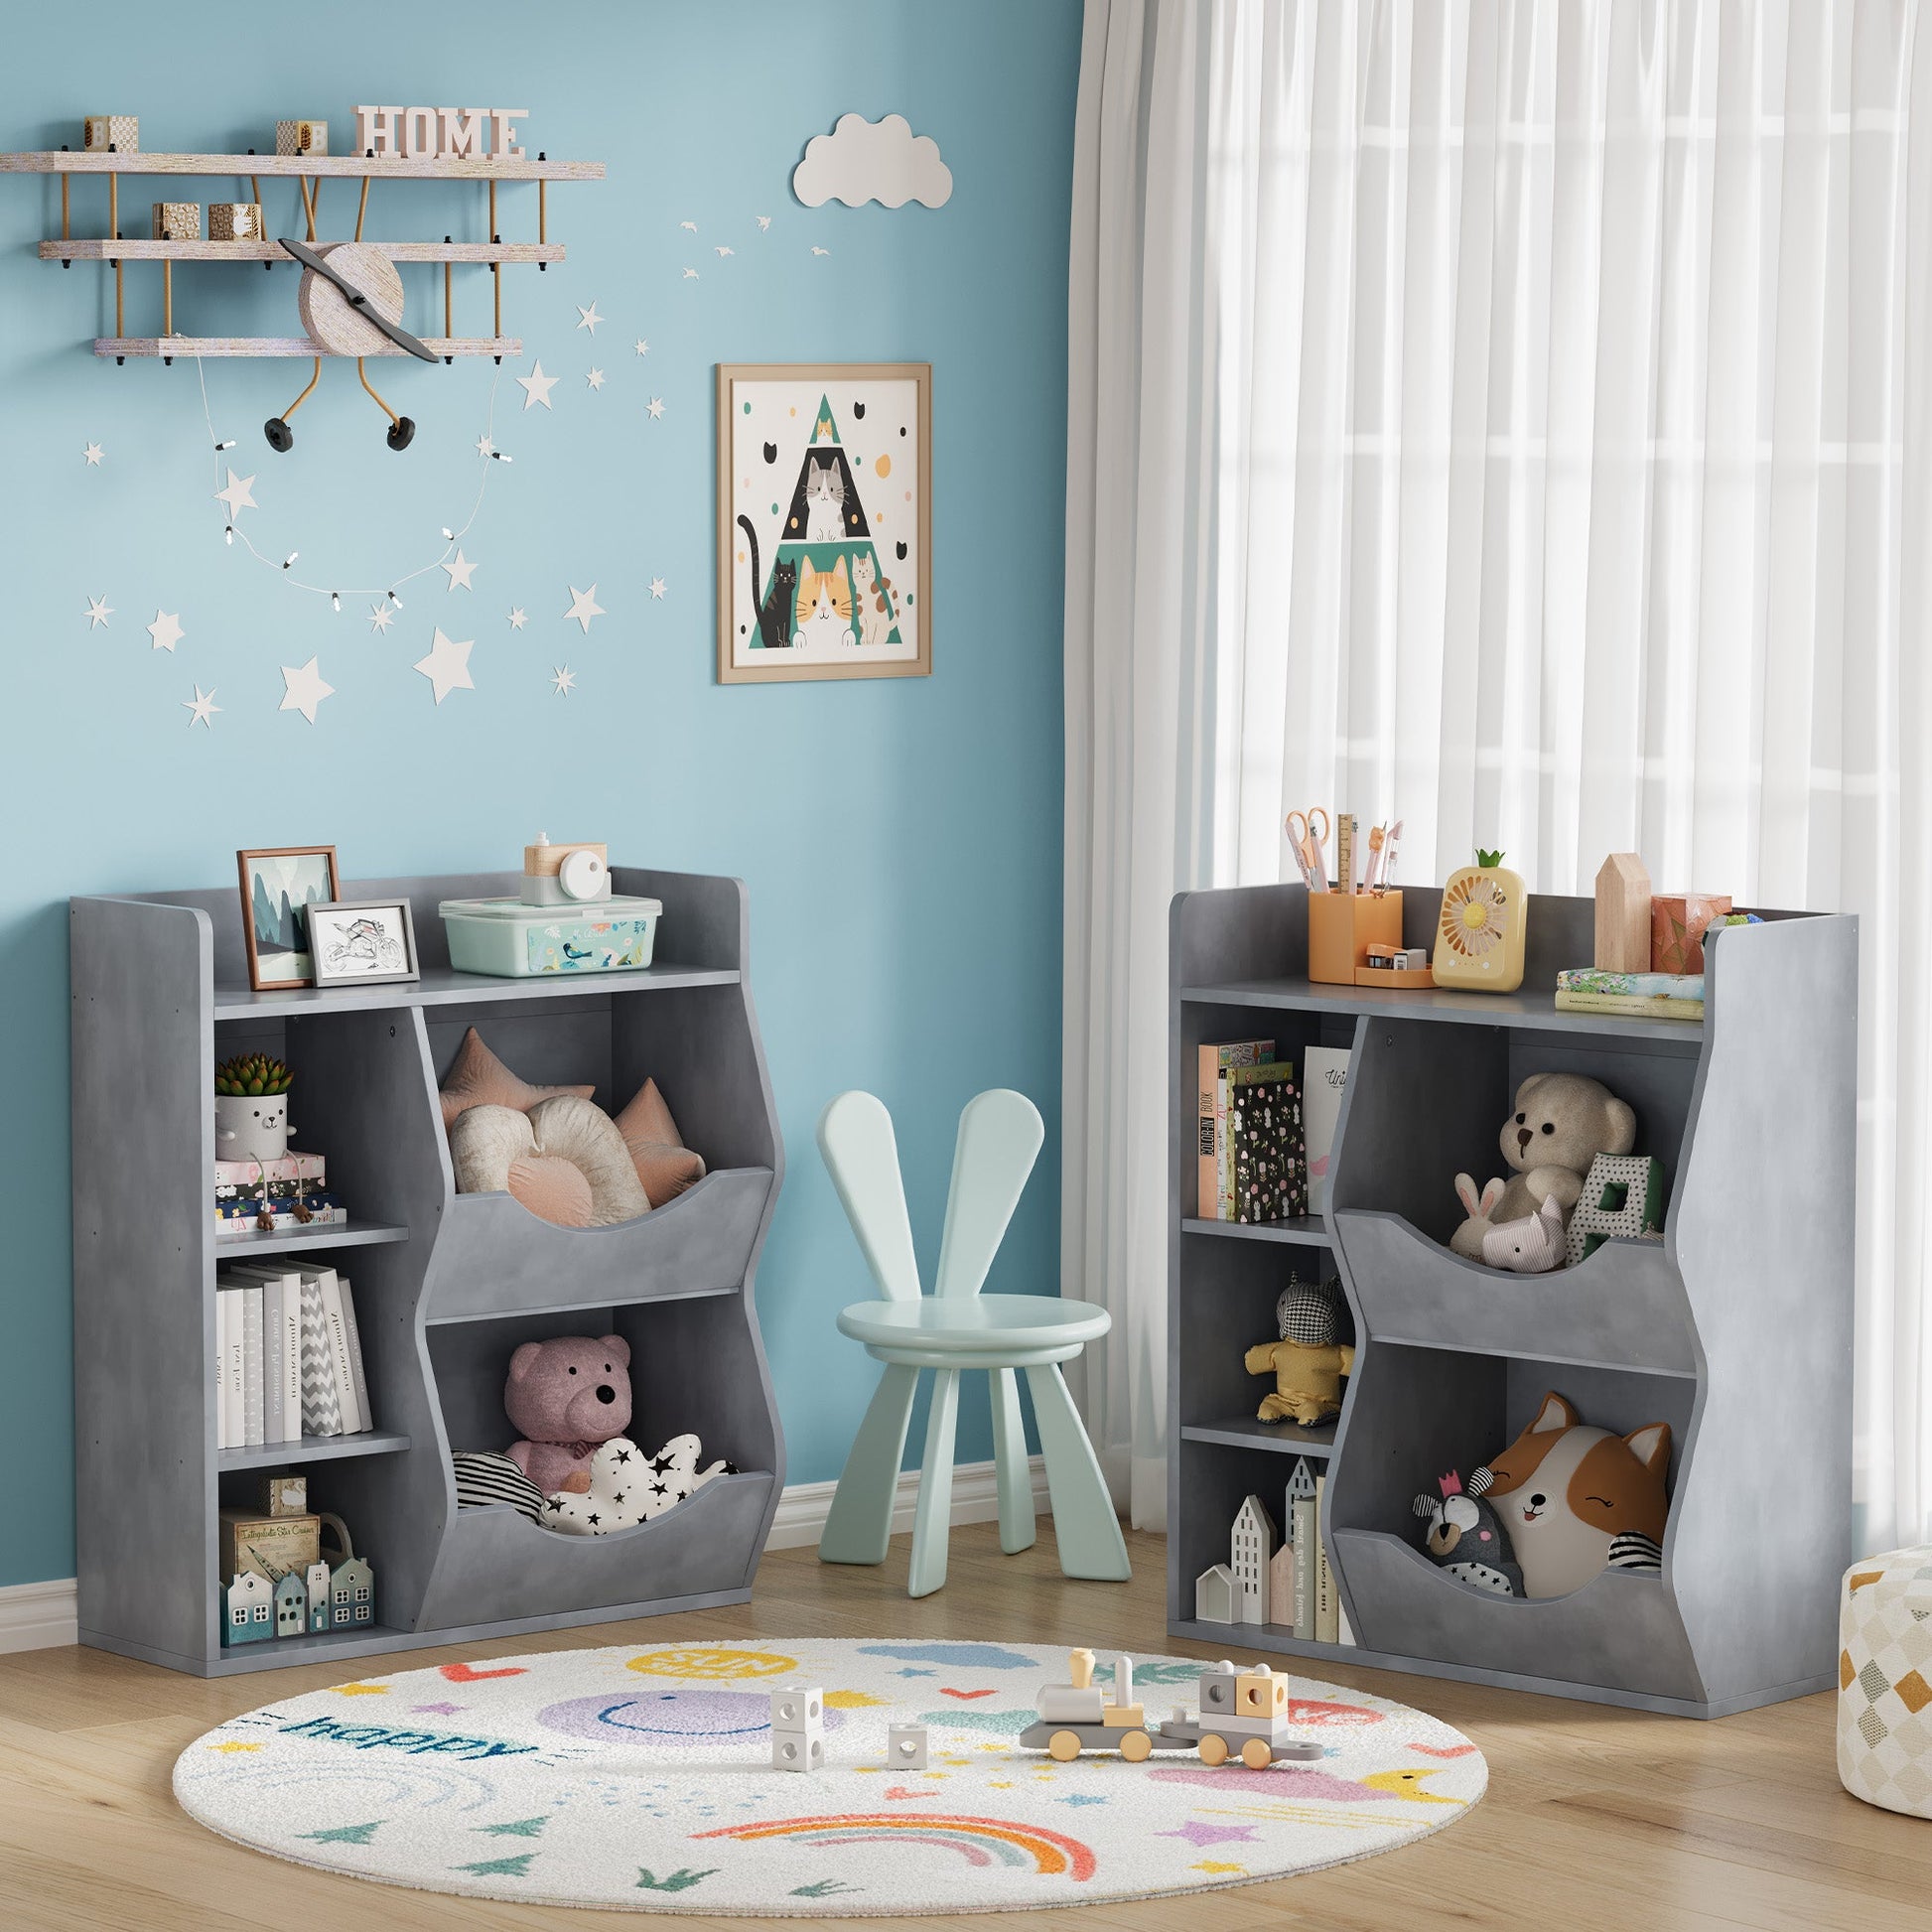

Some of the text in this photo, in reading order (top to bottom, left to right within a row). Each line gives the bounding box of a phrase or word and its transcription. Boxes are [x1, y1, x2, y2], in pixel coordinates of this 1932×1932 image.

[350, 104, 529, 161] HOME
[1200, 1091, 1214, 1157] COLOR-IN BOOK
[278, 1716, 540, 1761] happy
